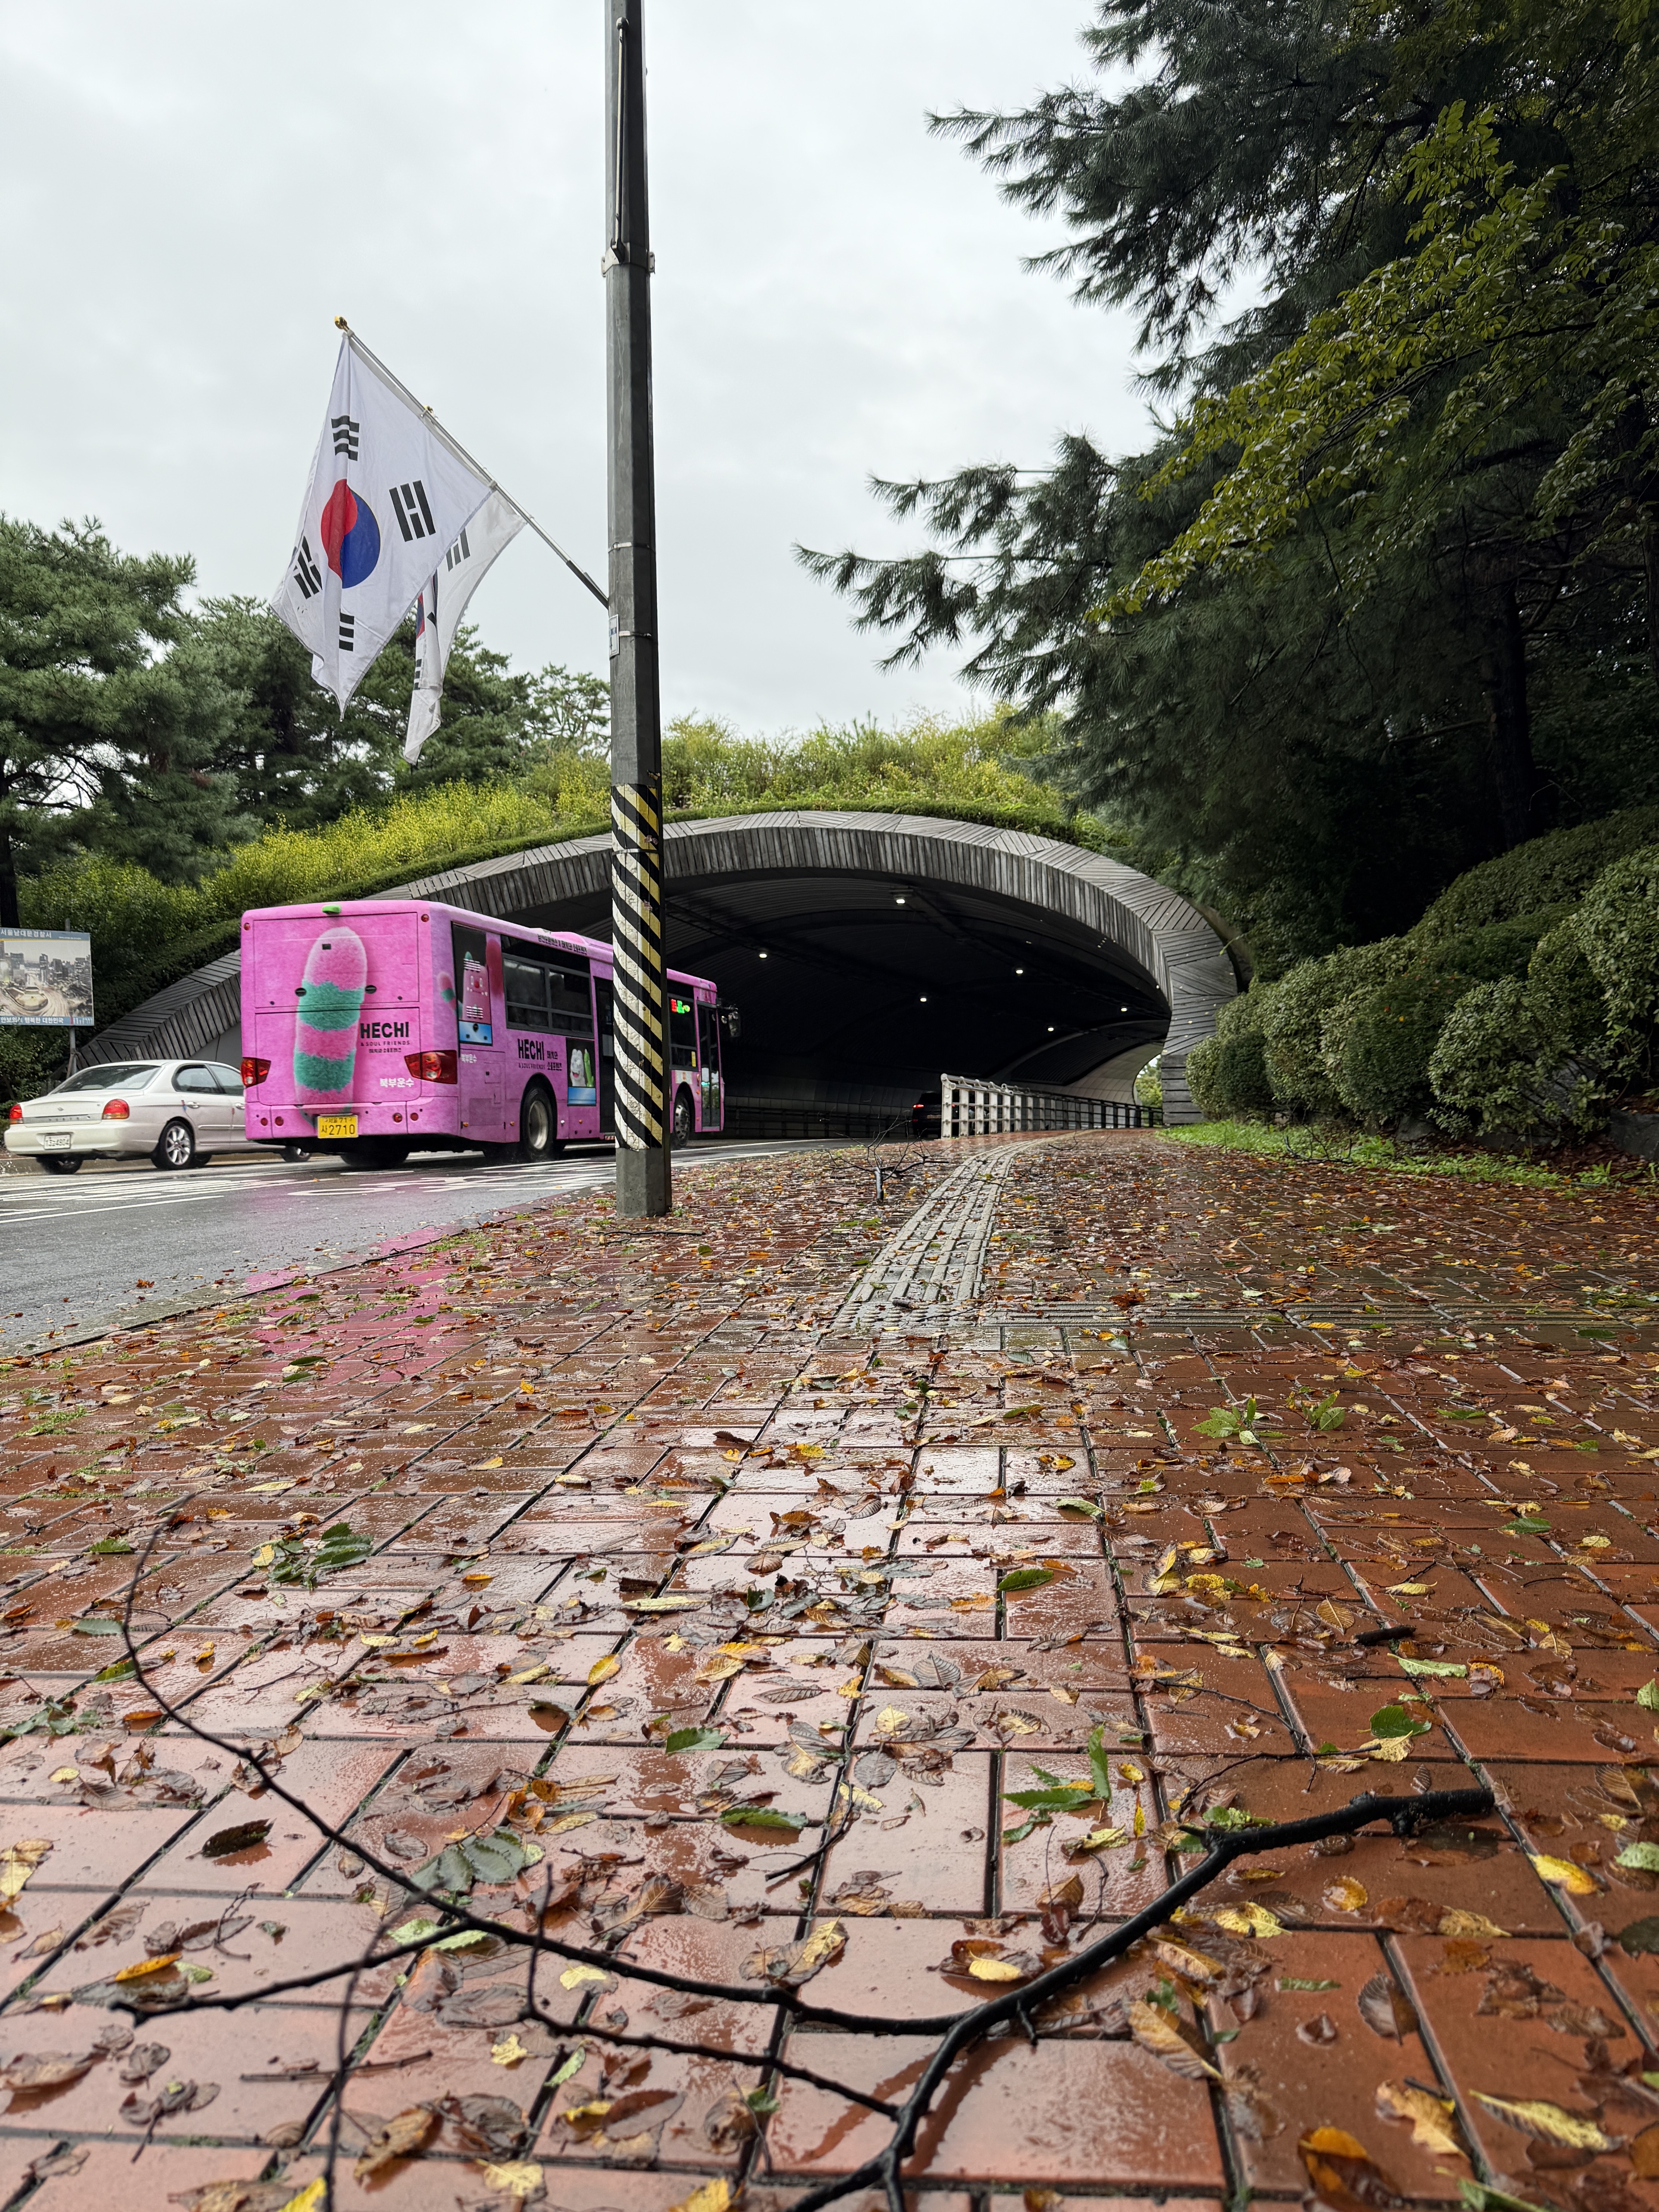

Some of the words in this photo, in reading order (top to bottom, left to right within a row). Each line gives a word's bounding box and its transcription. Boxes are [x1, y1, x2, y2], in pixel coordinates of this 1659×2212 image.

[360, 1022, 409, 1038] HECHI
[518, 1038, 544, 1060] HECHI
[380, 1078, 414, 1087] 북부운수
[329, 1125, 355, 1135] 2710
